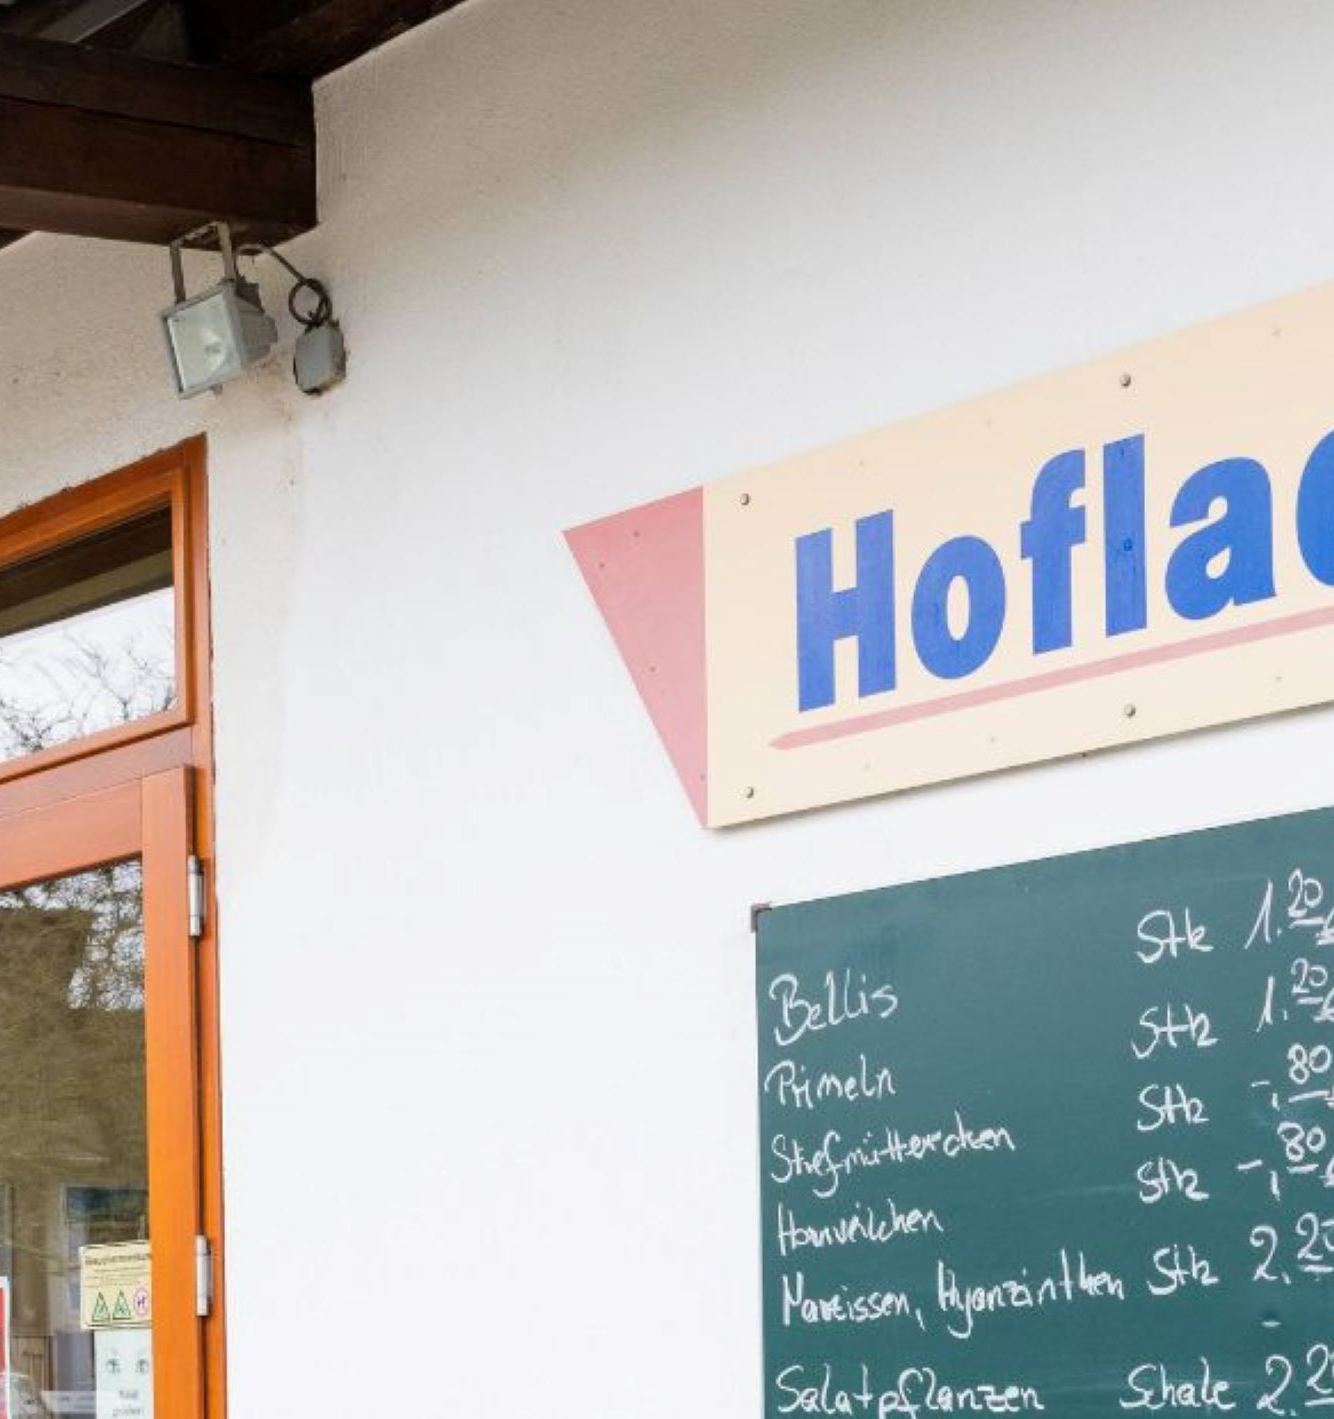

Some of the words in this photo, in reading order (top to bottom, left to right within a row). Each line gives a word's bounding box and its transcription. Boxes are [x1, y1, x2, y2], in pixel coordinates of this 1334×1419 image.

[768, 968, 899, 1046] Bellis
[1136, 906, 1215, 963] Stk
[763, 1053, 896, 1109] Primeln
[1130, 1002, 1218, 1060] Stk
[1136, 1083, 1210, 1132] Stk
[1136, 1156, 1210, 1204] Stk
[1147, 1243, 1220, 1296] Stk
[1118, 1355, 1237, 1411] Schale
